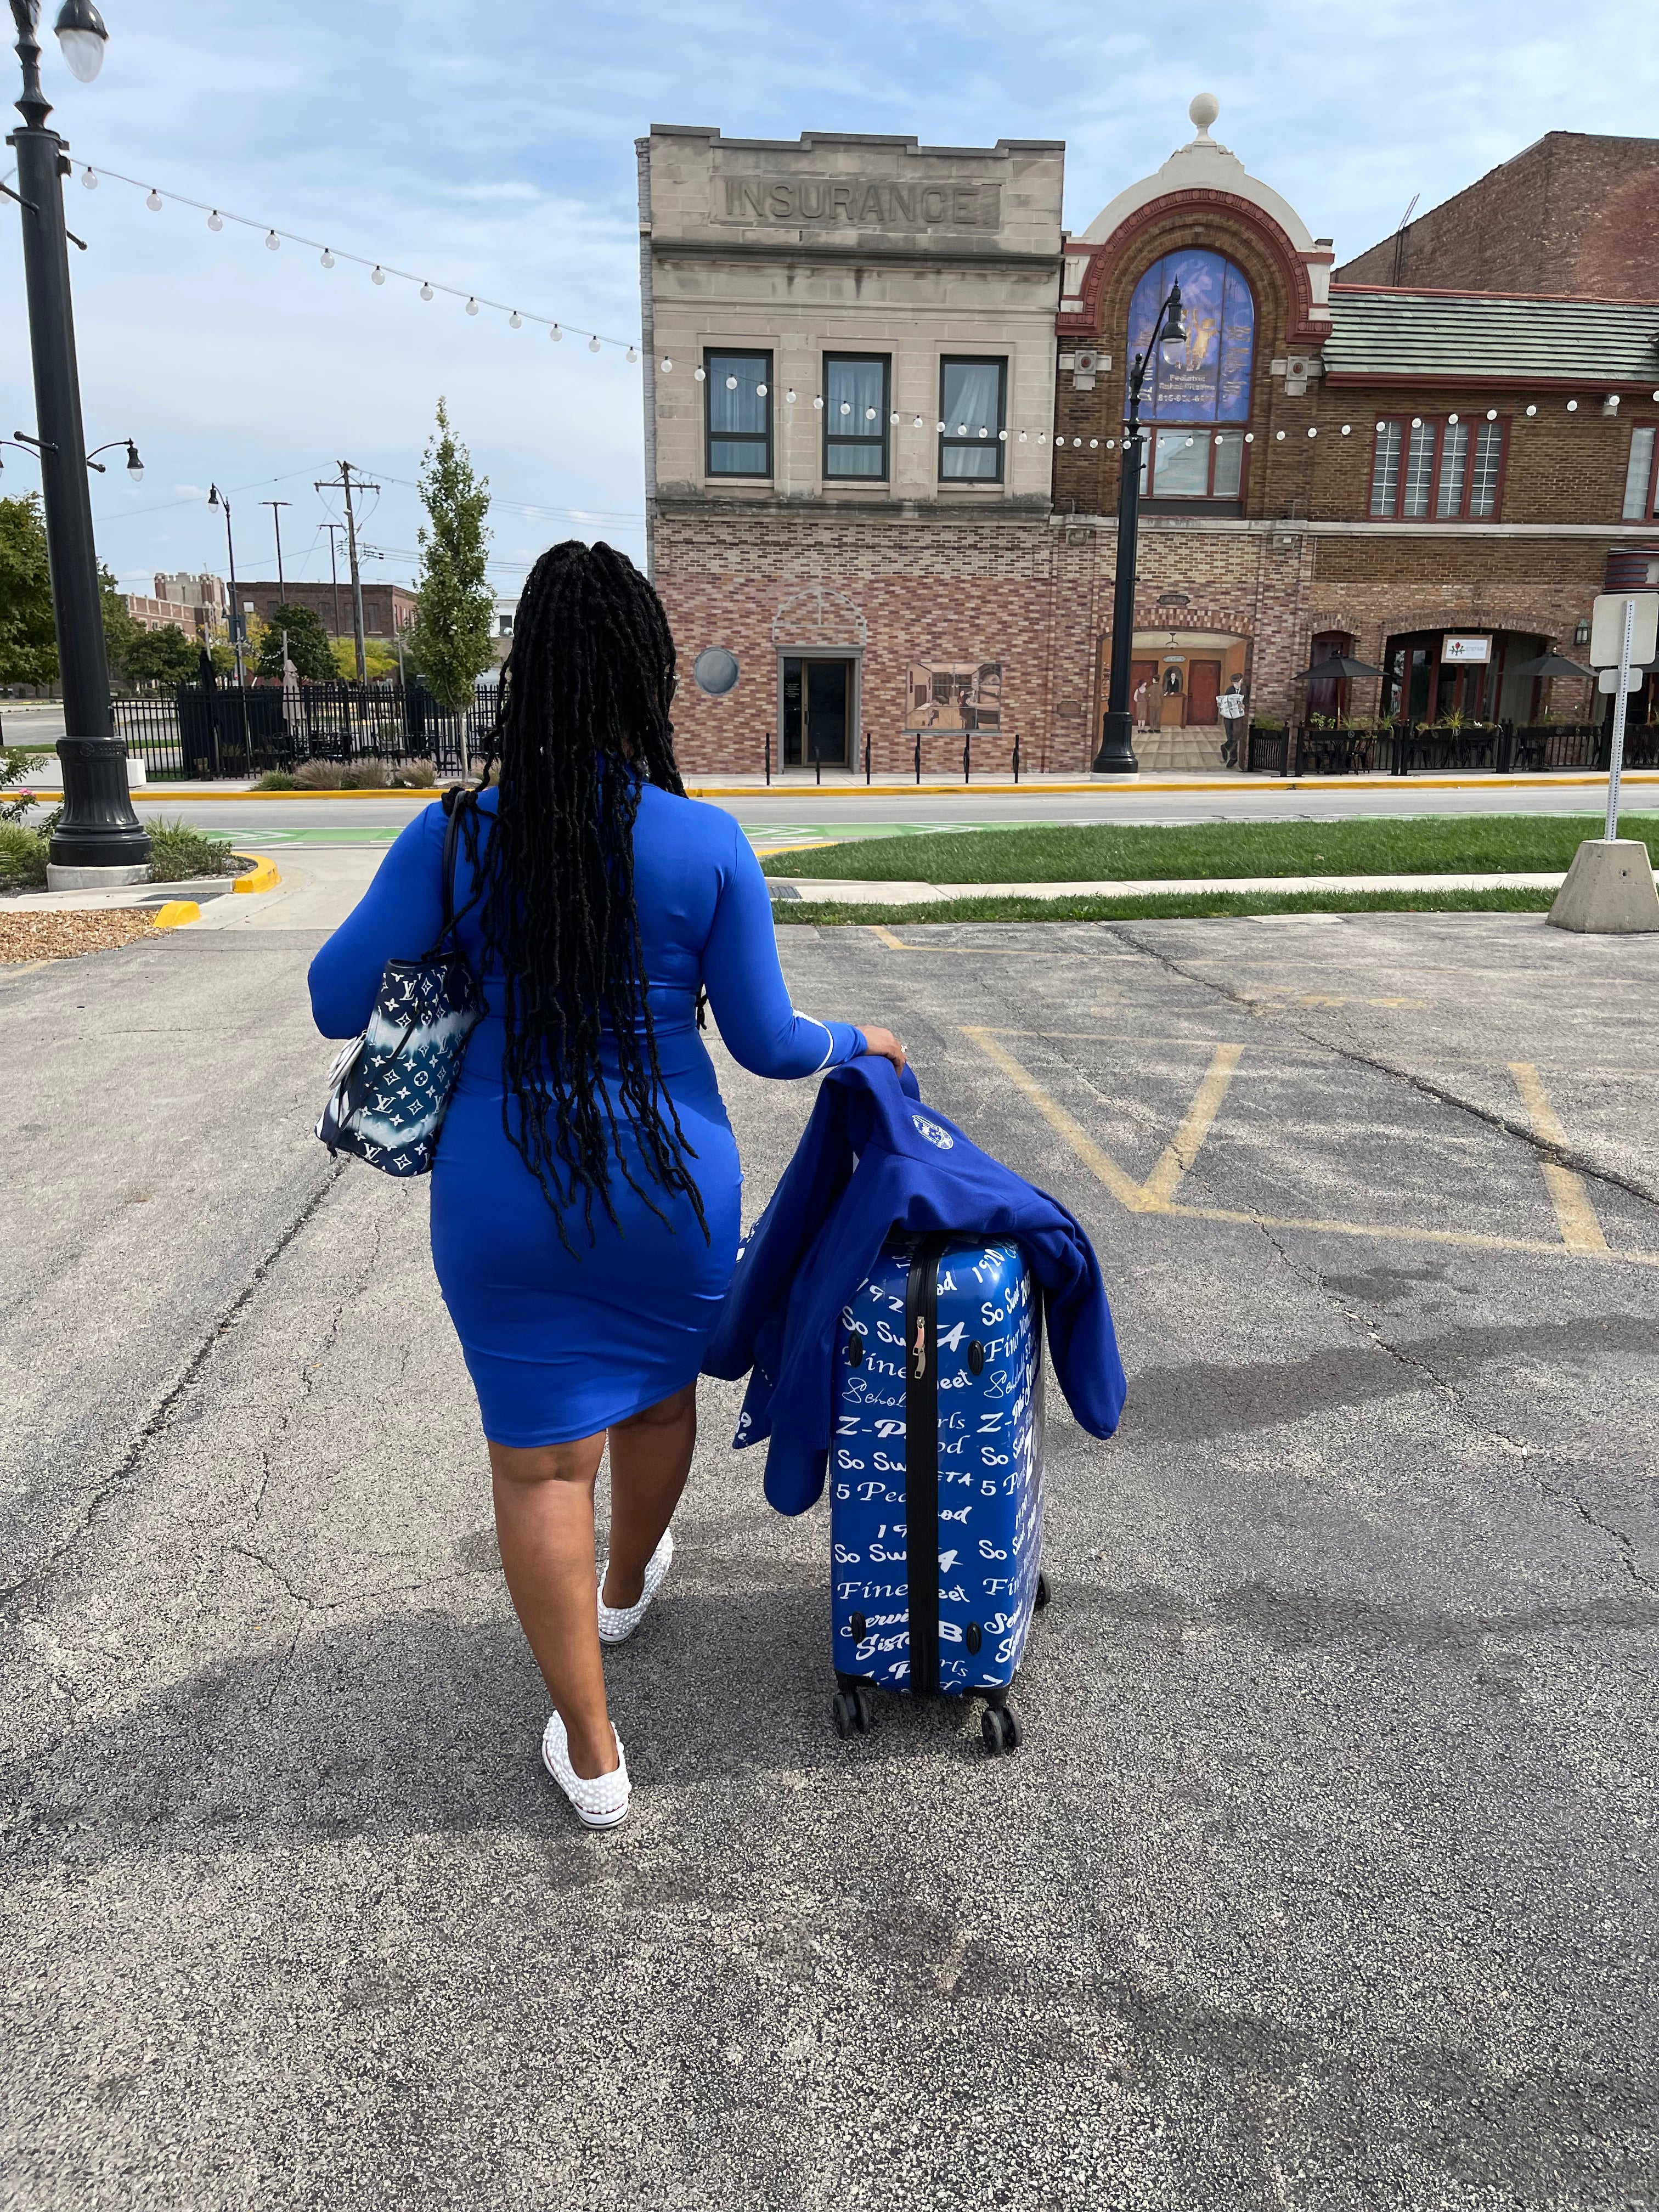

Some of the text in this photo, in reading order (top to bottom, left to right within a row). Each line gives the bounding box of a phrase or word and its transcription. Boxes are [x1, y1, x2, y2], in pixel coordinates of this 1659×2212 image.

[972, 1249, 1005, 1284] 1920
[842, 1305, 868, 1335] So
[981, 1301, 1005, 1326] So
[936, 1369, 973, 1390] eet
[838, 1449, 865, 1470] So
[981, 1447, 1009, 1466] So
[836, 1483, 850, 1500] 5
[980, 1480, 997, 1497] 5
[834, 1543, 861, 1564] So
[978, 1539, 1008, 1561] So
